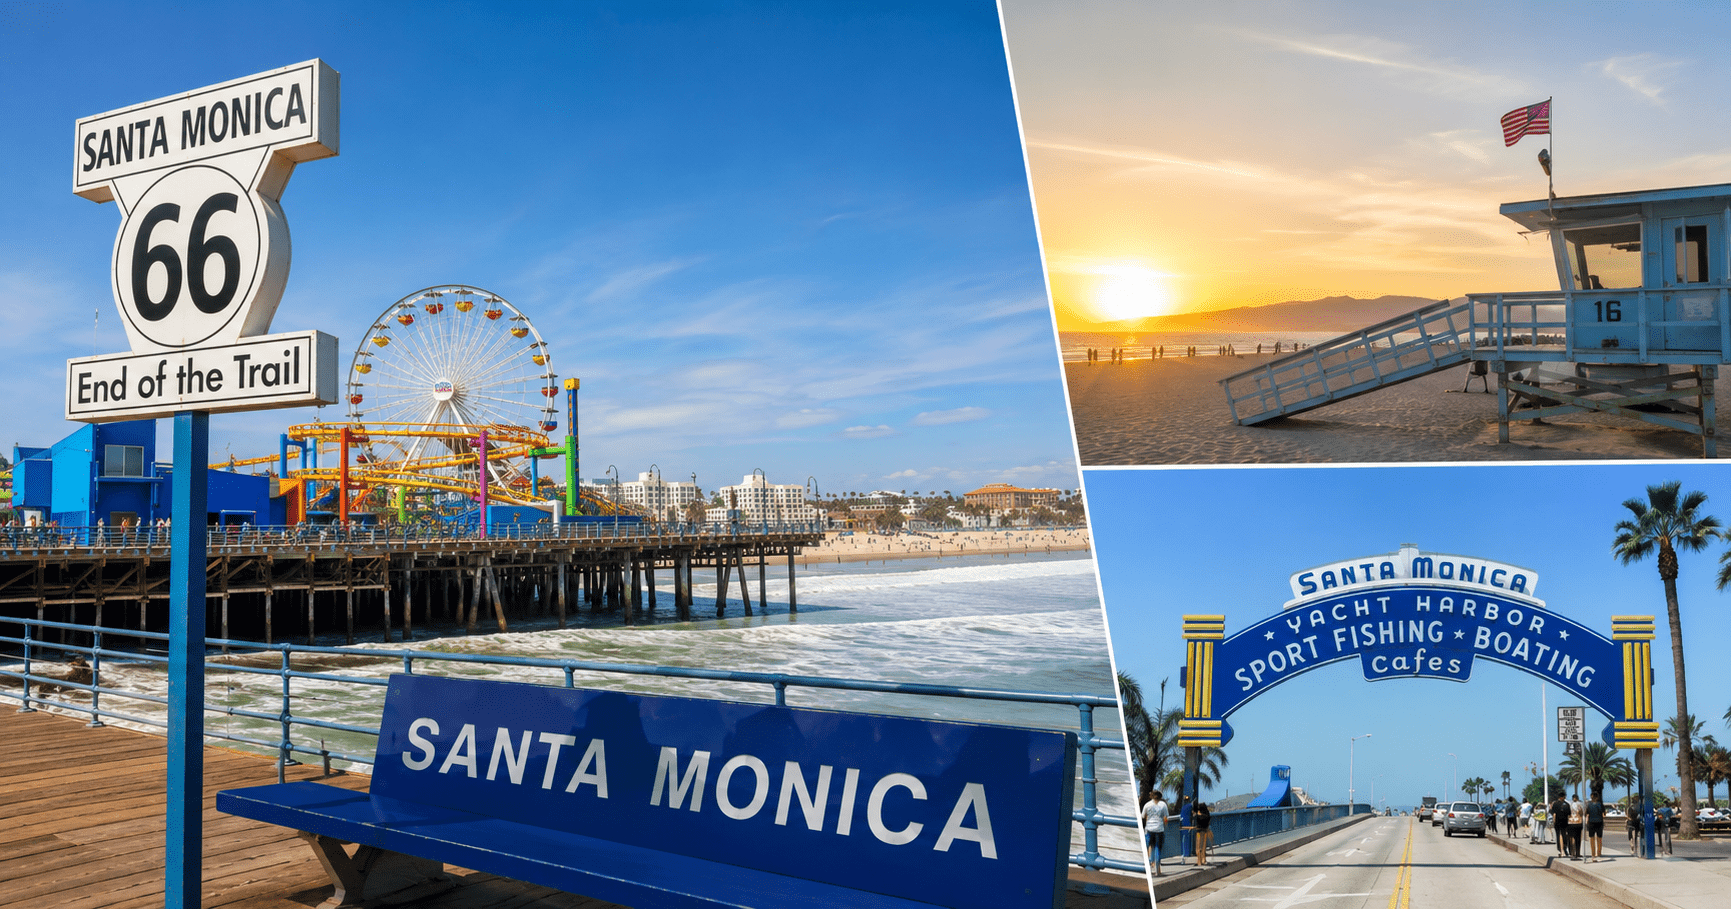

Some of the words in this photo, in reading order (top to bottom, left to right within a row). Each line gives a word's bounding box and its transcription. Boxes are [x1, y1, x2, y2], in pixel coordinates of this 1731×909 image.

[83, 116, 169, 172] SANTA
[181, 82, 306, 150] MONICA
[132, 192, 240, 322] 66
[1594, 300, 1622, 322] 16
[78, 365, 127, 404] End
[138, 360, 167, 397] of
[176, 358, 222, 394] the
[233, 346, 300, 389] Trail
[1298, 561, 1395, 596] SANTA
[1412, 556, 1527, 594] MONICA
[1287, 596, 1391, 635] YACHT
[1416, 596, 1545, 635] HARBOR
[1234, 635, 1319, 692] SPORT
[1334, 620, 1444, 655] FISHING
[1474, 626, 1596, 689] BOATING
[402, 717, 608, 799] SANTA
[650, 746, 999, 860] MONICA
